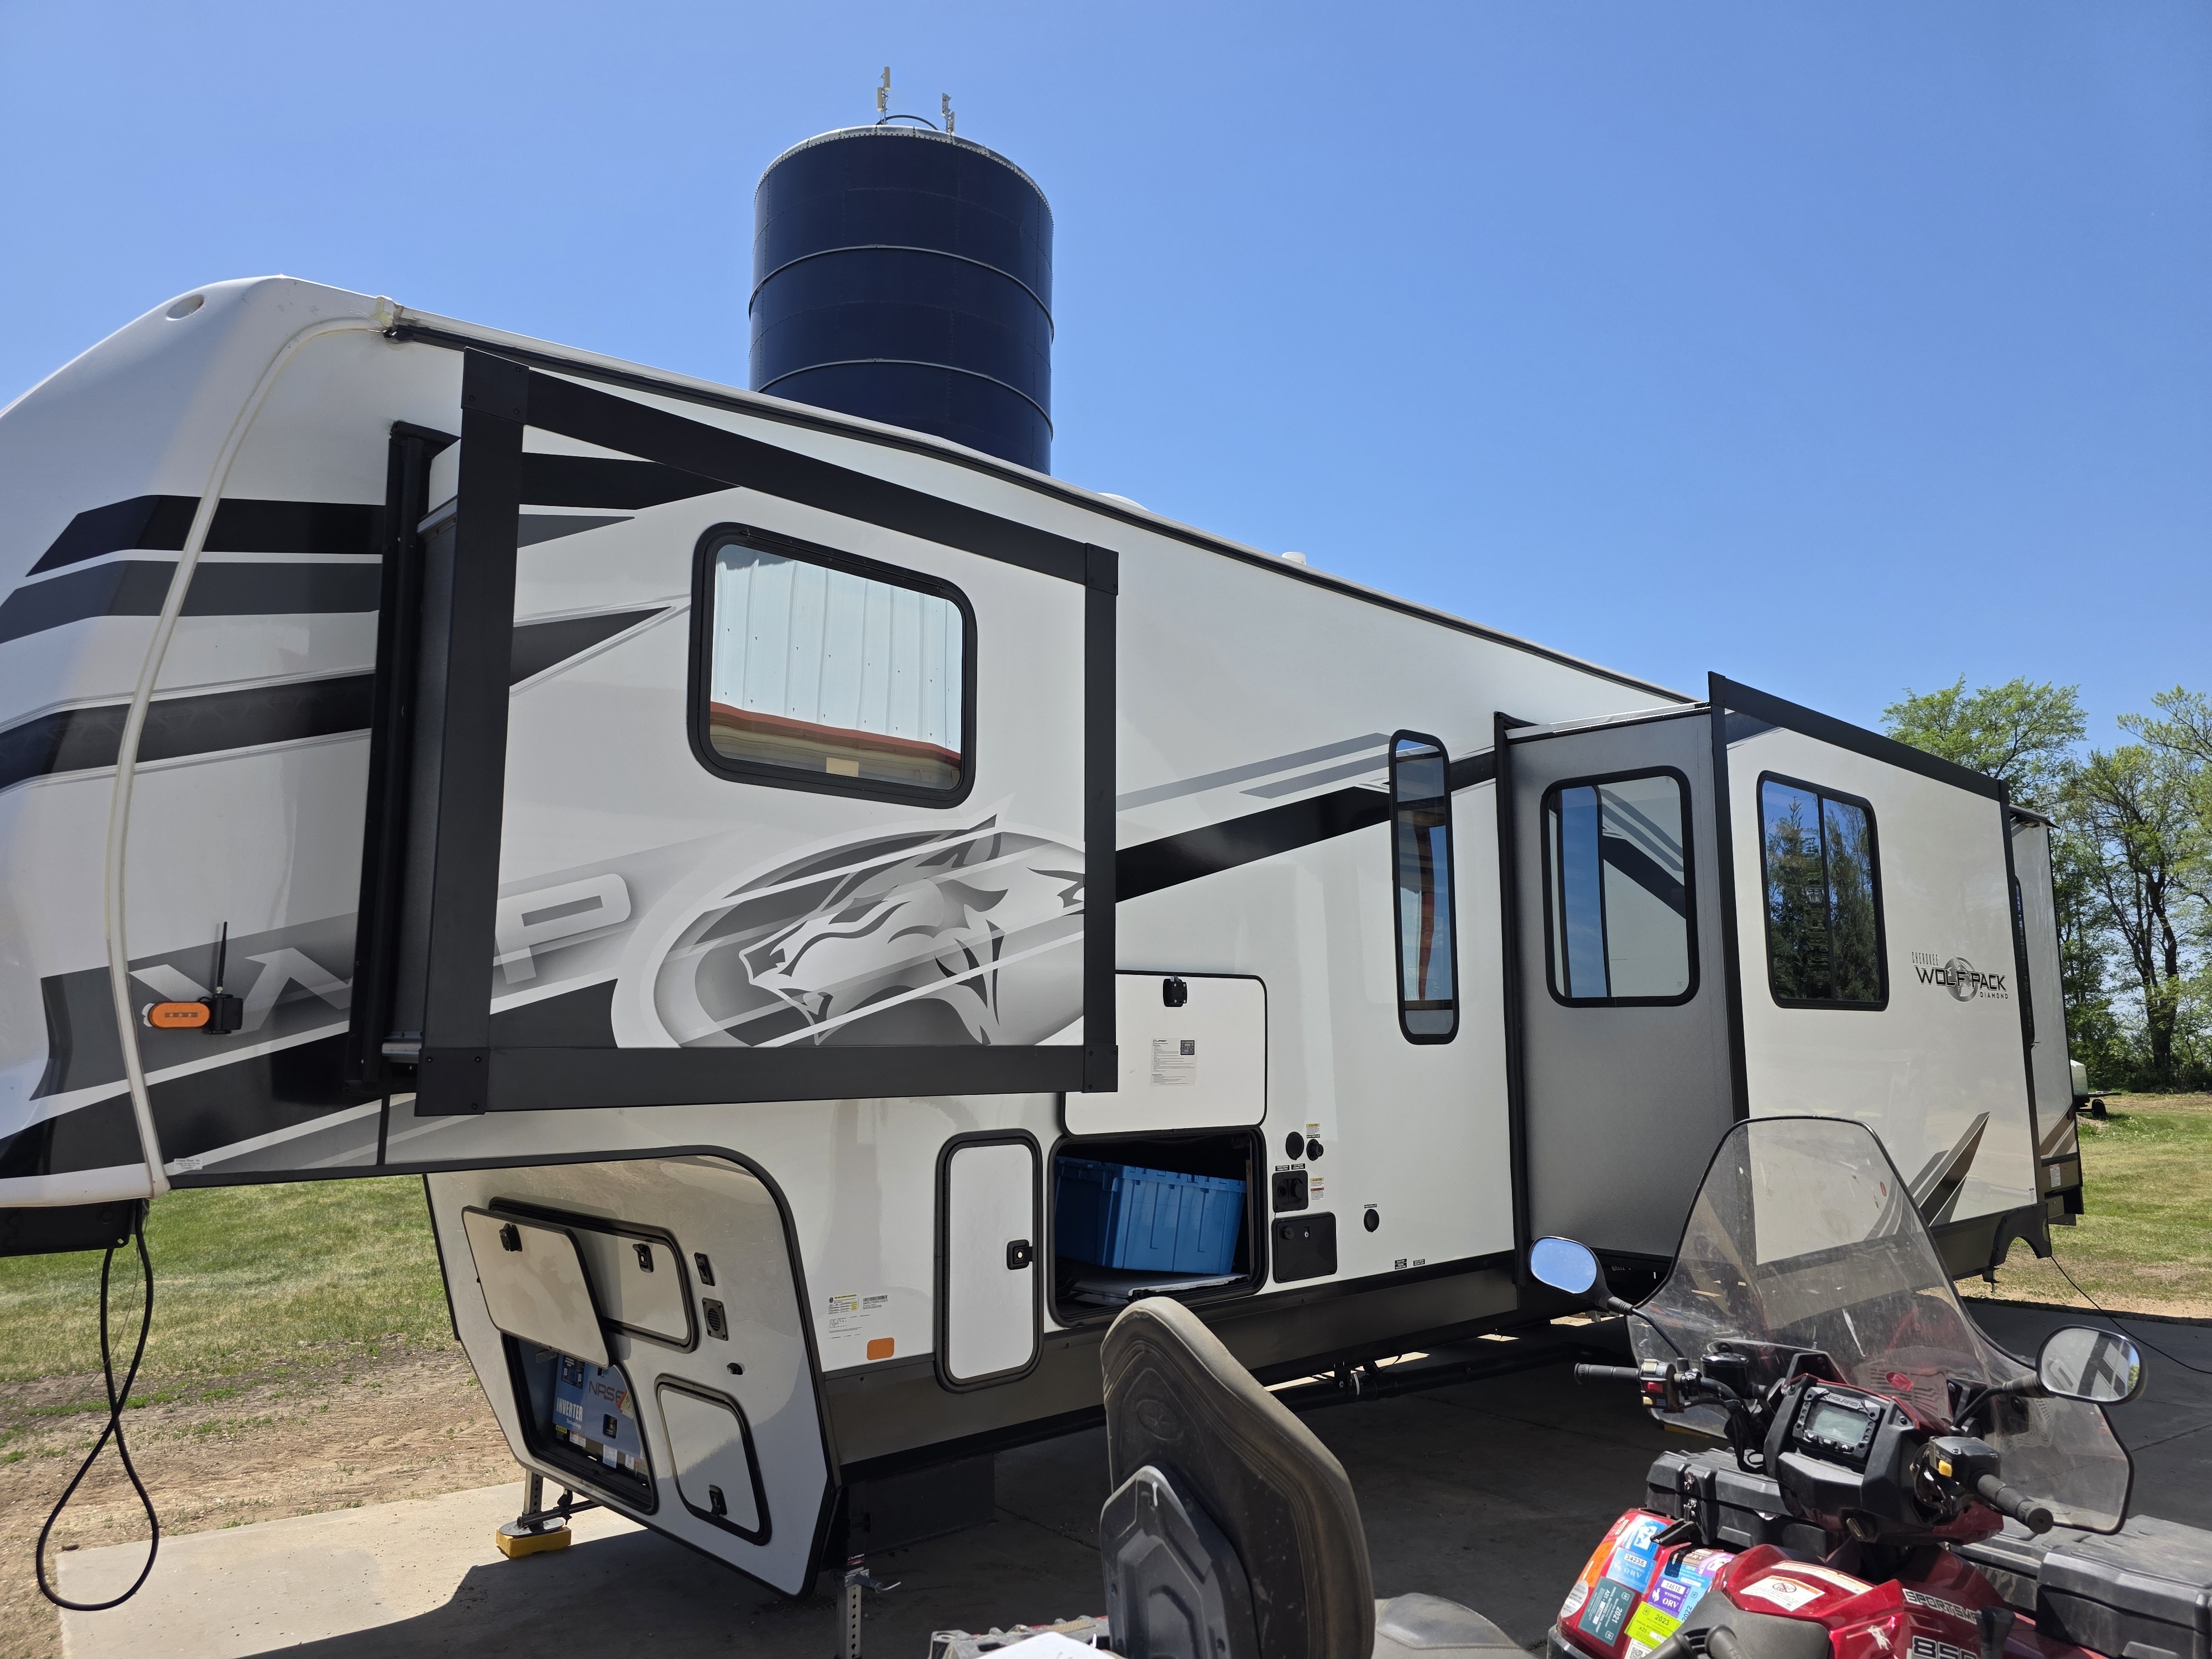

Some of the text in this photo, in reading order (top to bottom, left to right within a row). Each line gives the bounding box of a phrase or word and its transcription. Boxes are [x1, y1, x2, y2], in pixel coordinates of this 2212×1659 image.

[1912, 951, 1938, 966] CHEROKEE
[1914, 965, 2007, 992] WOLF PACK
[1828, 1395, 1859, 1407] POLARIS
[556, 1397, 583, 1422] INVERTER
[566, 1418, 582, 1430] Technology
[1626, 1554, 1645, 1566] 34235
[1623, 1567, 1642, 1579] ORV
[1666, 1582, 1681, 1592] 14618
[1664, 1591, 1682, 1601] WYOMING
[1662, 1598, 1679, 1608] ORV
[1610, 1606, 1623, 1624] 2021
[1682, 1605, 1692, 1621] 2022
[1655, 1614, 1670, 1625] 2023
